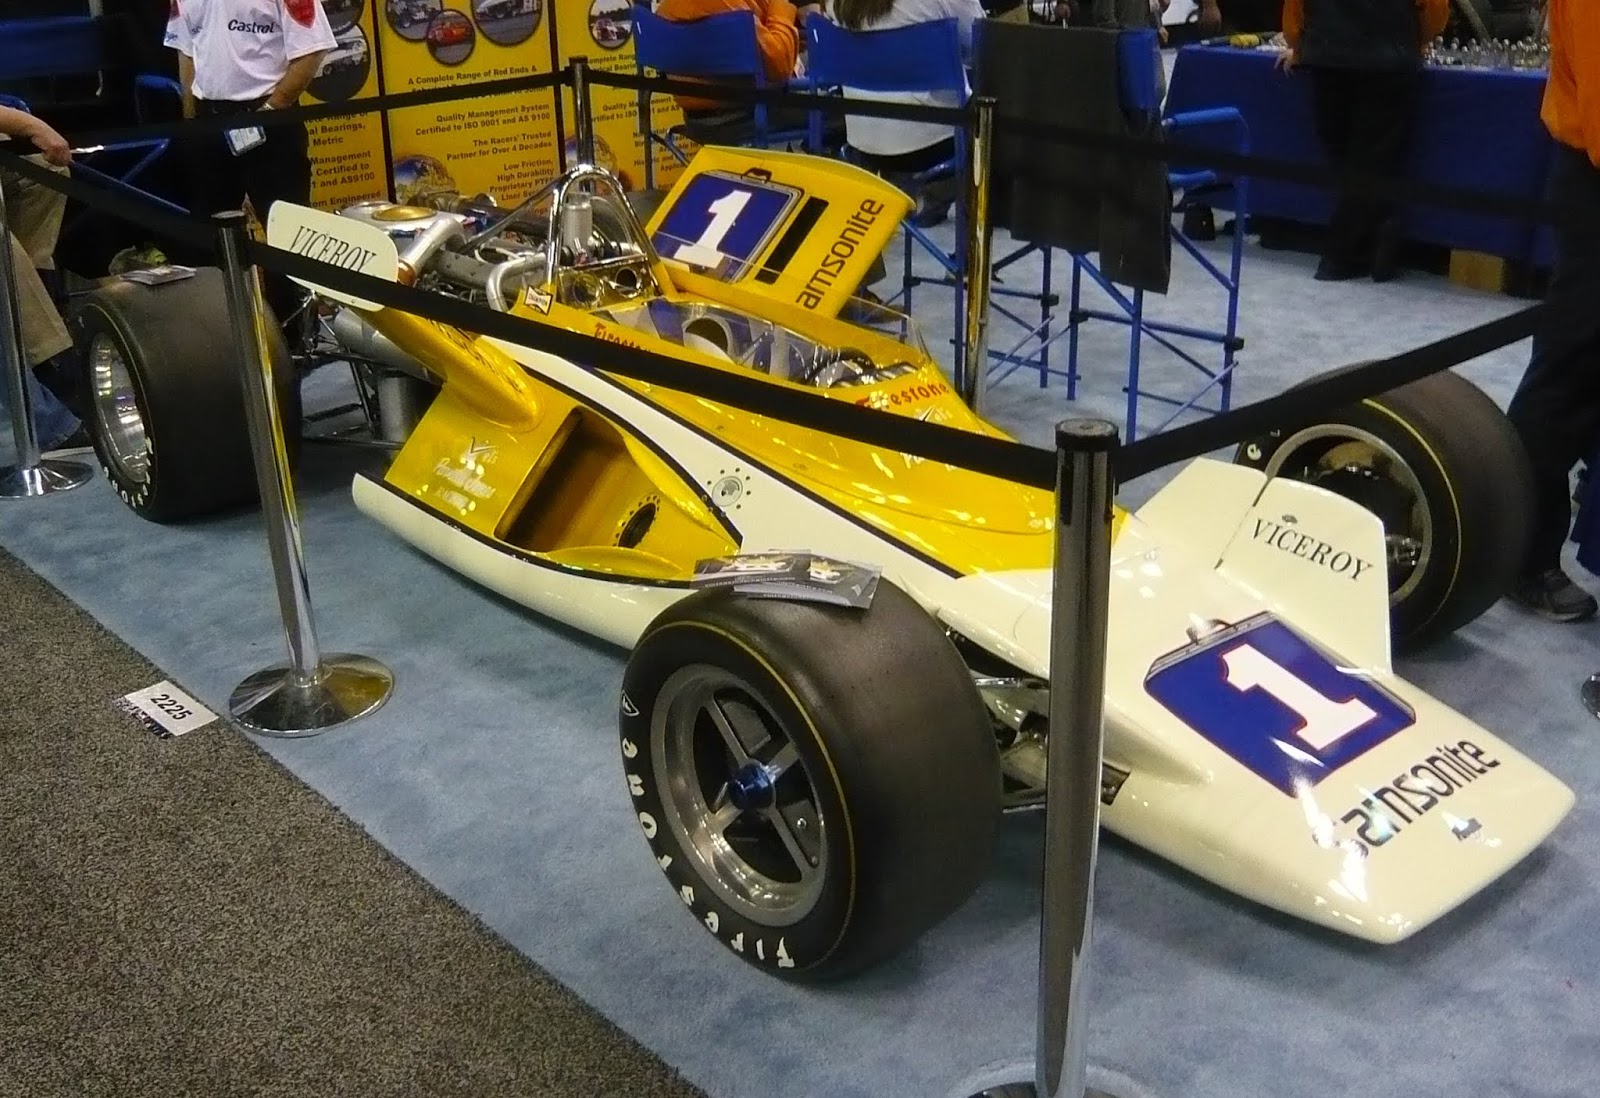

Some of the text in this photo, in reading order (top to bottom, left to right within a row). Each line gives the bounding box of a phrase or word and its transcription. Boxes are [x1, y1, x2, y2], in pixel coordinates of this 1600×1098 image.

[227, 19, 276, 34] Castrol
[416, 74, 455, 85] Complete
[456, 71, 482, 80] Range
[493, 68, 508, 76] Rod
[510, 66, 529, 74] Ends
[436, 103, 550, 123] Quality Management System
[603, 103, 627, 111] Quality
[415, 113, 550, 136] Certified to ISO 9001 and AS 9100
[592, 111, 614, 122] rtified
[321, 122, 366, 134] Bearings,
[313, 137, 344, 147] Metric
[473, 139, 488, 147] The
[521, 131, 552, 141] Trusted
[311, 150, 371, 165] Management
[447, 151, 477, 161] Partner
[478, 149, 490, 157] for
[492, 147, 510, 155] Over
[519, 141, 552, 151] Decades
[316, 162, 370, 176] Certified to
[521, 160, 554, 168] Friction,
[320, 178, 338, 188] and
[340, 172, 375, 184] AS9100
[497, 168, 555, 182] High Durability
[490, 181, 533, 193] Proprietary
[330, 191, 381, 206] Engineered
[673, 190, 752, 268] 1
[290, 225, 377, 272] VICEROY
[796, 198, 884, 310] amsonite
[1253, 518, 1374, 582] VICEROY
[1219, 643, 1378, 752] 1
[150, 693, 194, 720] 2225
